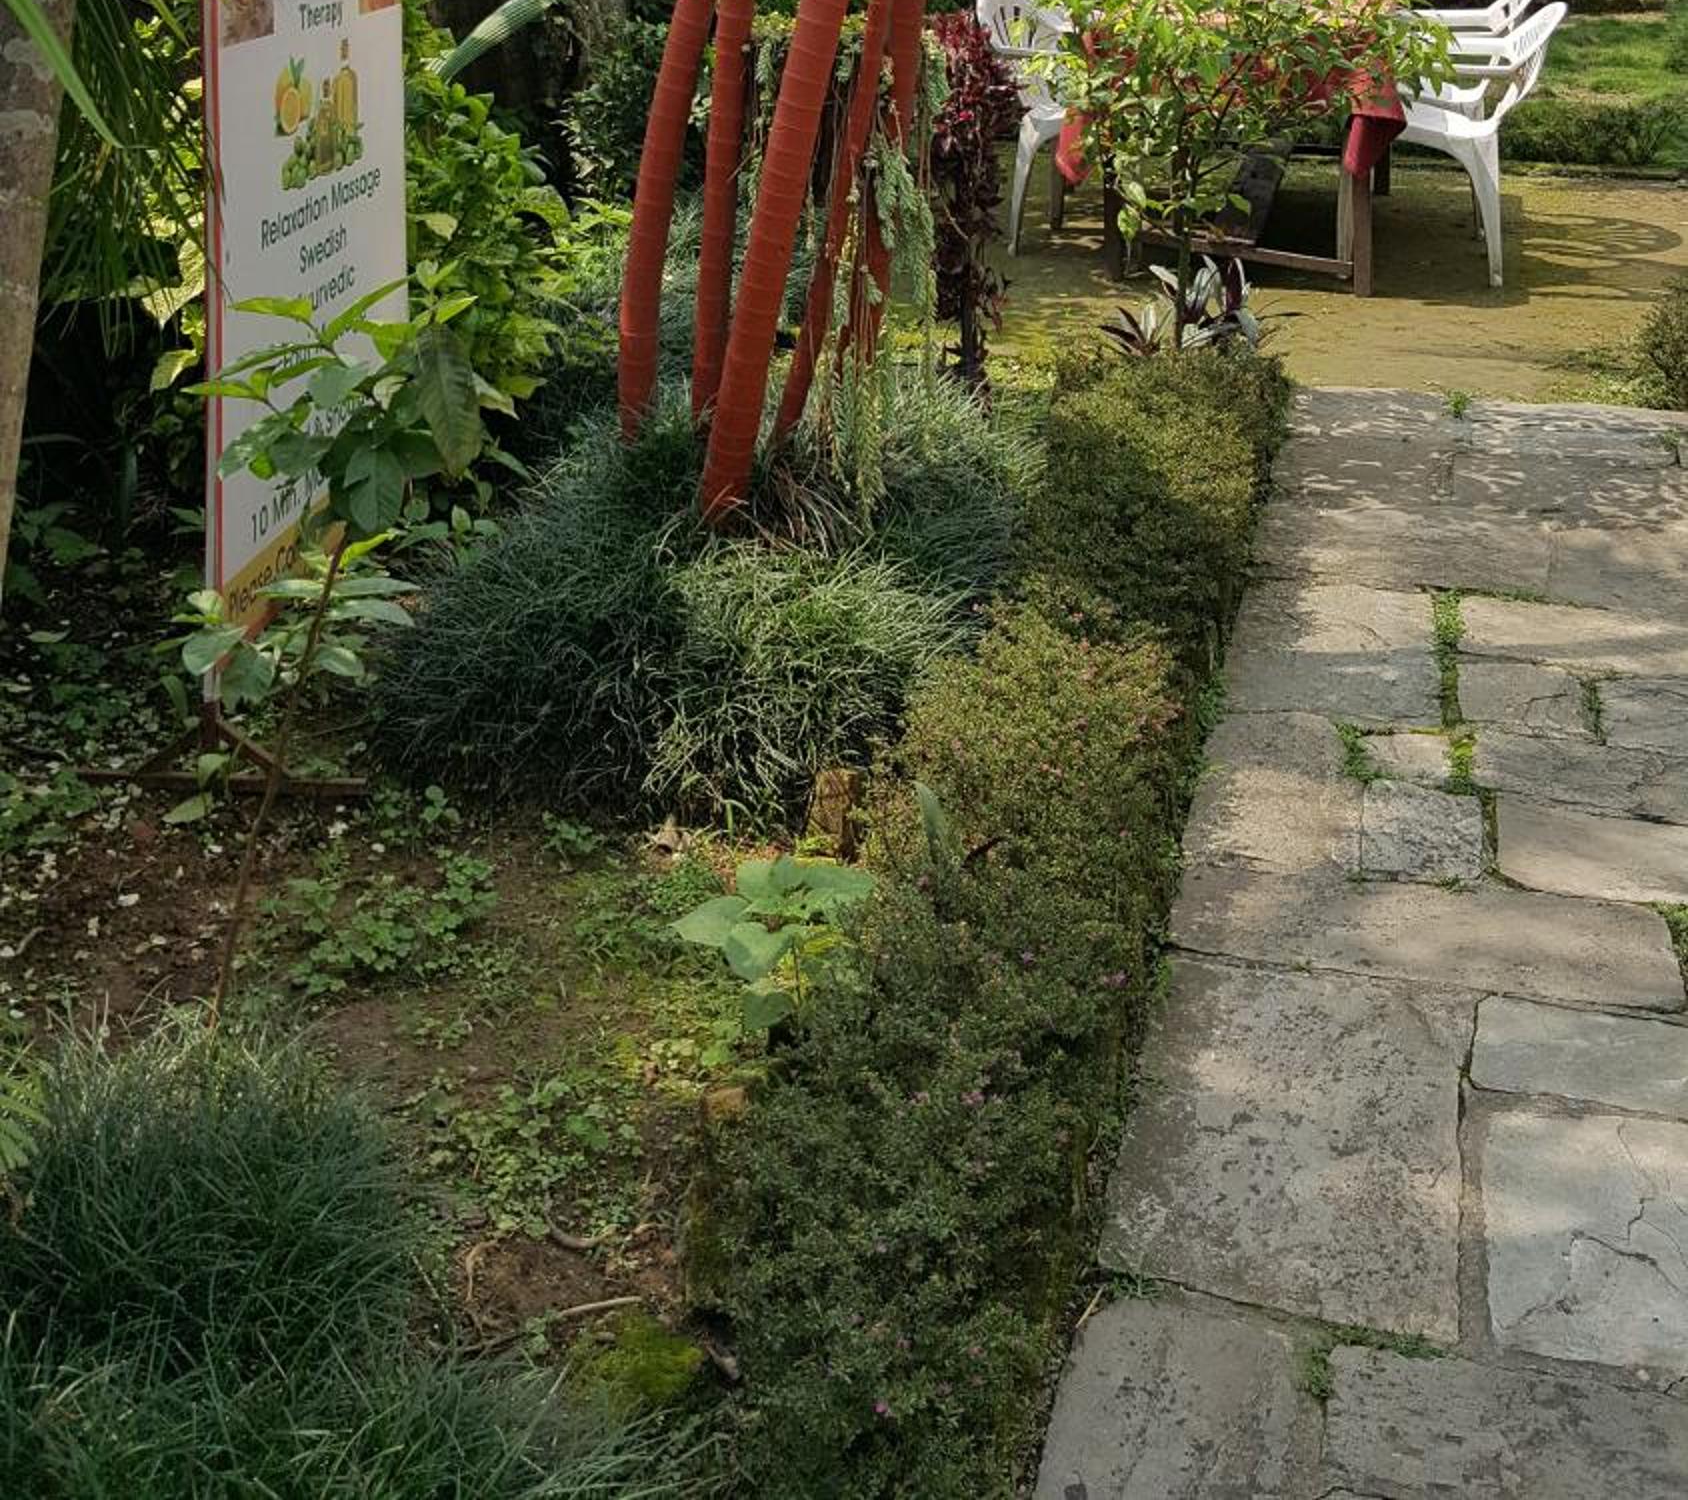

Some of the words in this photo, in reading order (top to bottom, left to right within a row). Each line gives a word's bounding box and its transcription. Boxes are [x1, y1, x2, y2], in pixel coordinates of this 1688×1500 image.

[299, 1, 343, 31] Therapy
[261, 195, 329, 250] Relaxation
[332, 167, 381, 211] Massage
[300, 222, 347, 273] Swedish
[298, 264, 355, 310] urvedic
[252, 505, 268, 543] 10
